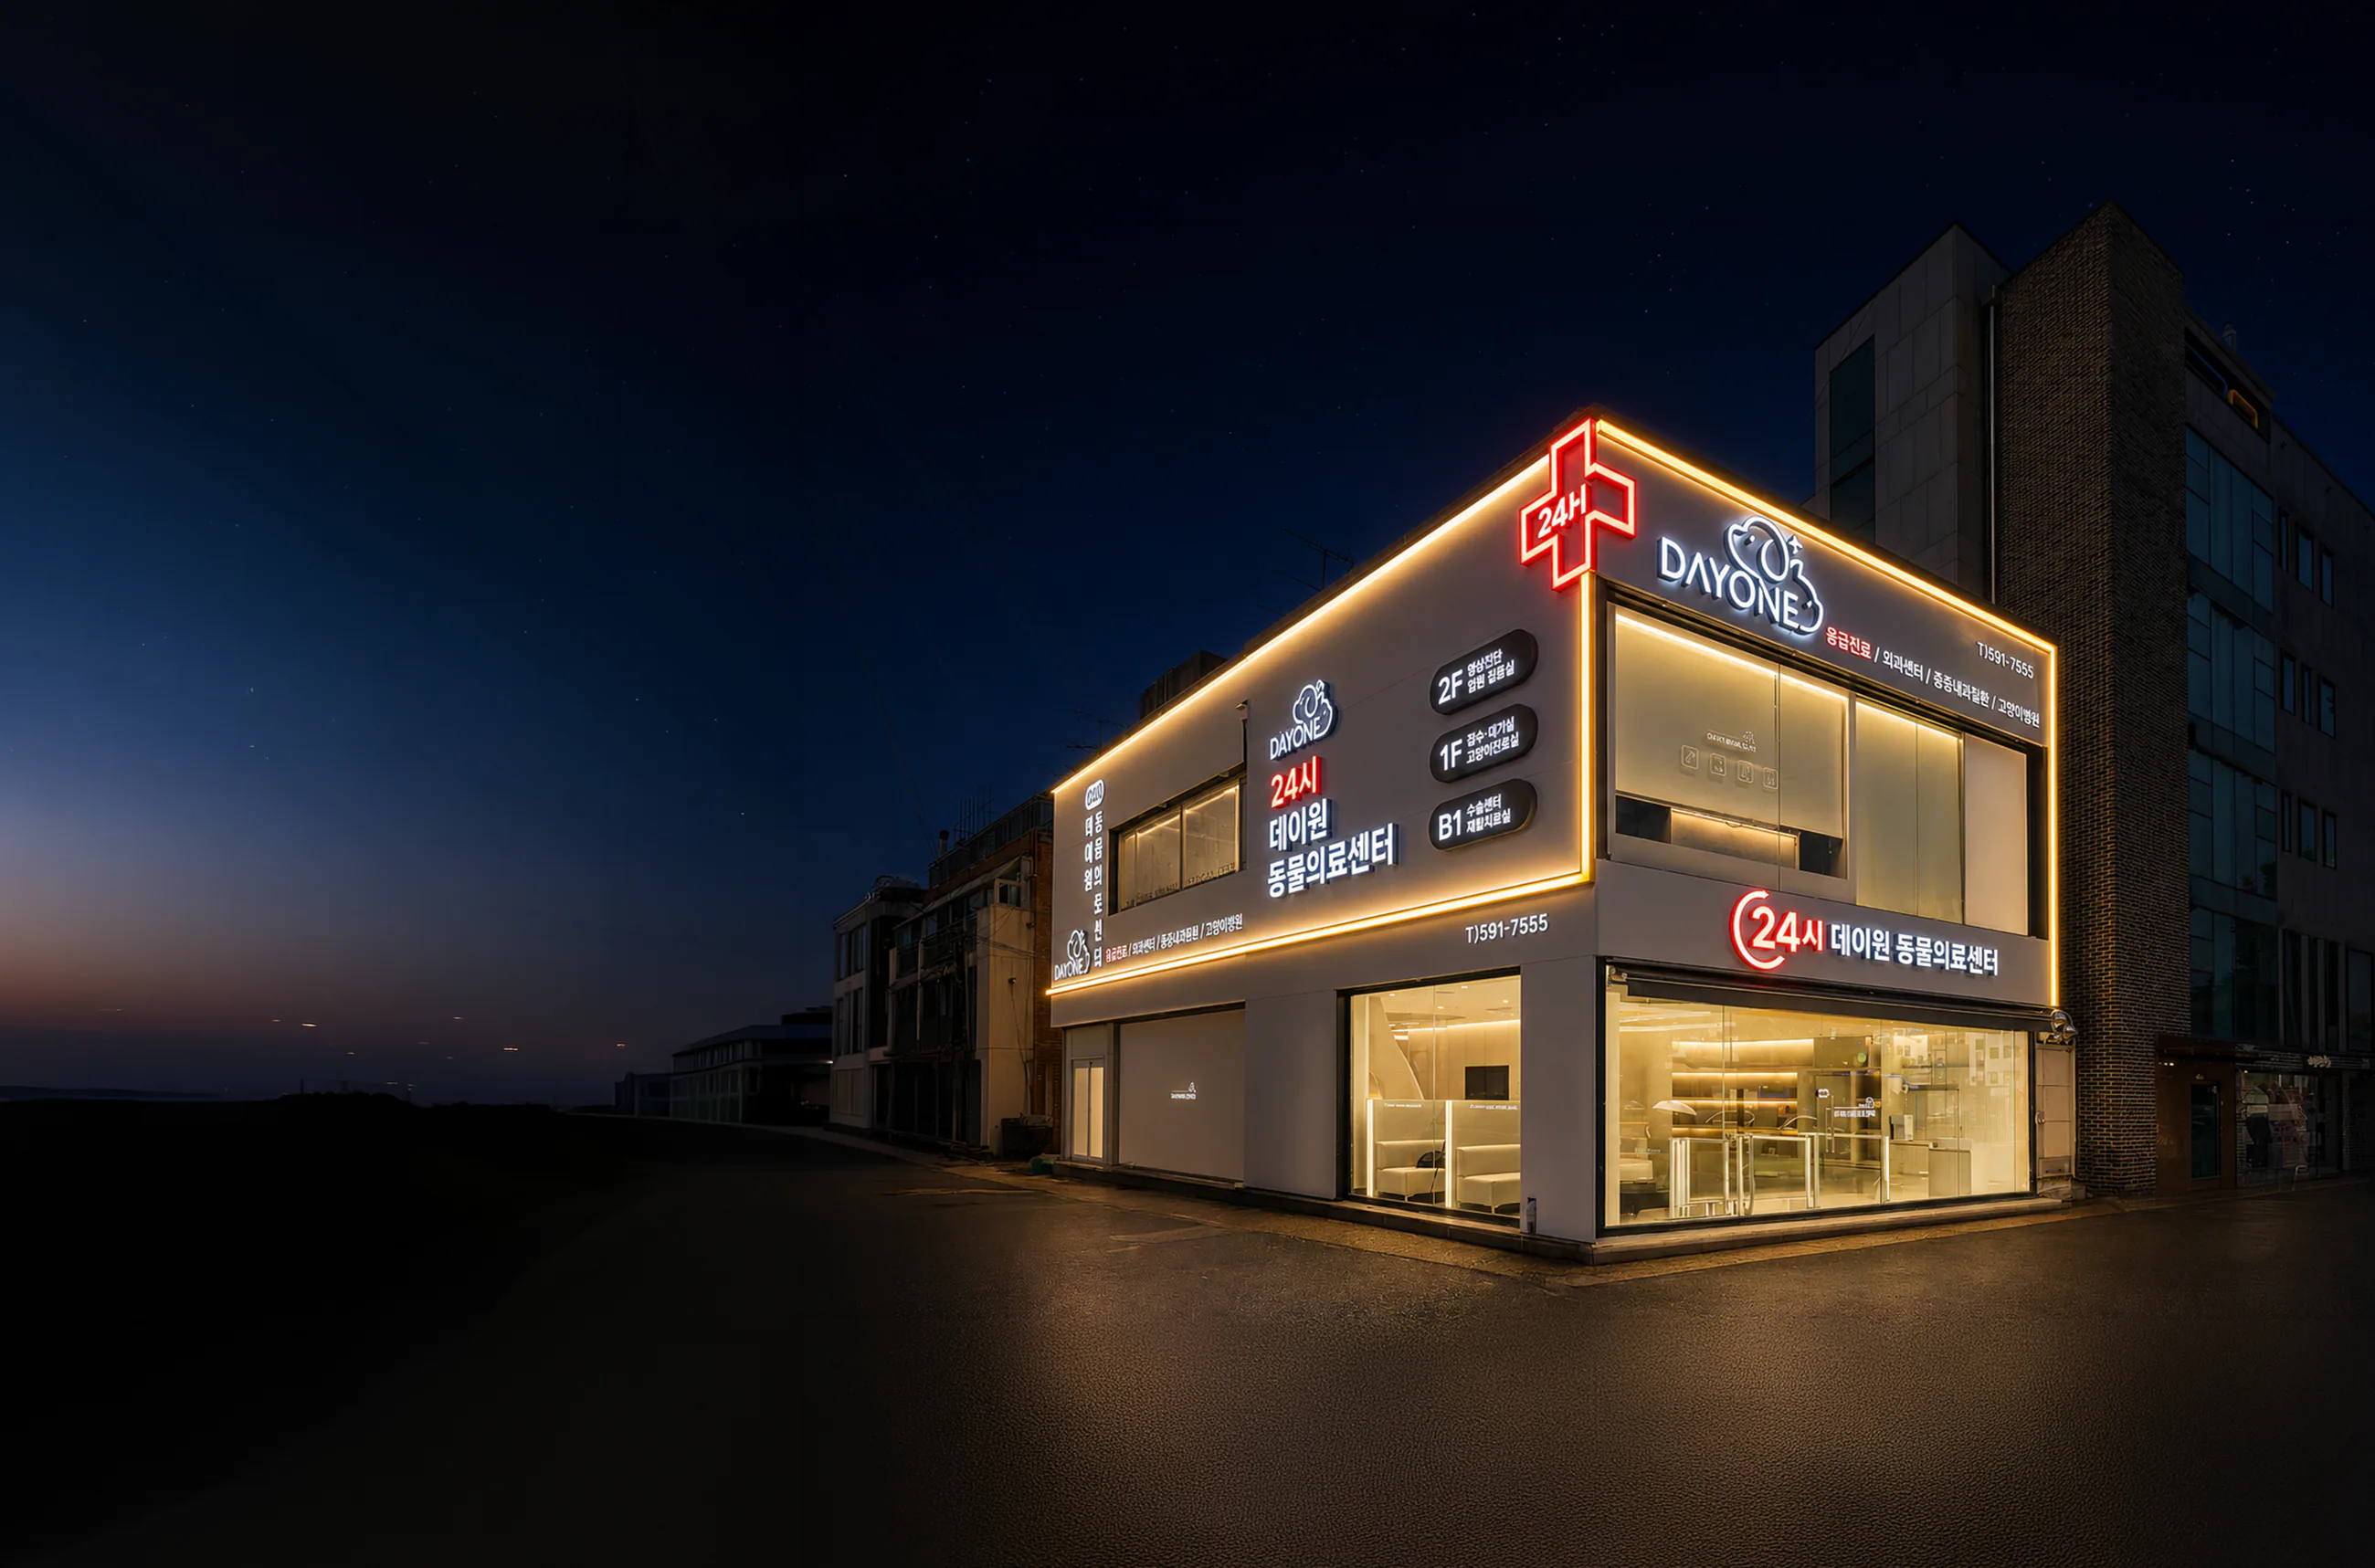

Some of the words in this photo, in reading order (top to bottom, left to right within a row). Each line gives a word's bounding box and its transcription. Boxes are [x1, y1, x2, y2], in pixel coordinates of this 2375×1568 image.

[1537, 484, 1589, 538] 24H
[1660, 536, 1800, 631] DAYONE
[1467, 648, 1503, 677] 영상진단
[1825, 626, 1872, 659] 응급진료
[1883, 650, 1924, 681] 외과센터
[1998, 699, 2040, 728] 고양이병원
[1977, 641, 2034, 679] T)591-7555
[1439, 669, 1463, 705] 2F
[1270, 717, 1321, 760] DAYONE
[1440, 739, 1462, 771] 1F
[1271, 755, 1318, 809] 24시
[1269, 798, 1328, 851] 데이원
[1439, 809, 1462, 841] B1
[1466, 794, 1502, 817] 수술센터
[1268, 823, 1395, 899] 동물의료센터
[1465, 913, 1548, 944] T)591-7555
[1751, 905, 1824, 953] 24시
[1831, 923, 1890, 962] 데이원
[1895, 933, 1999, 976] 동물의료센터
